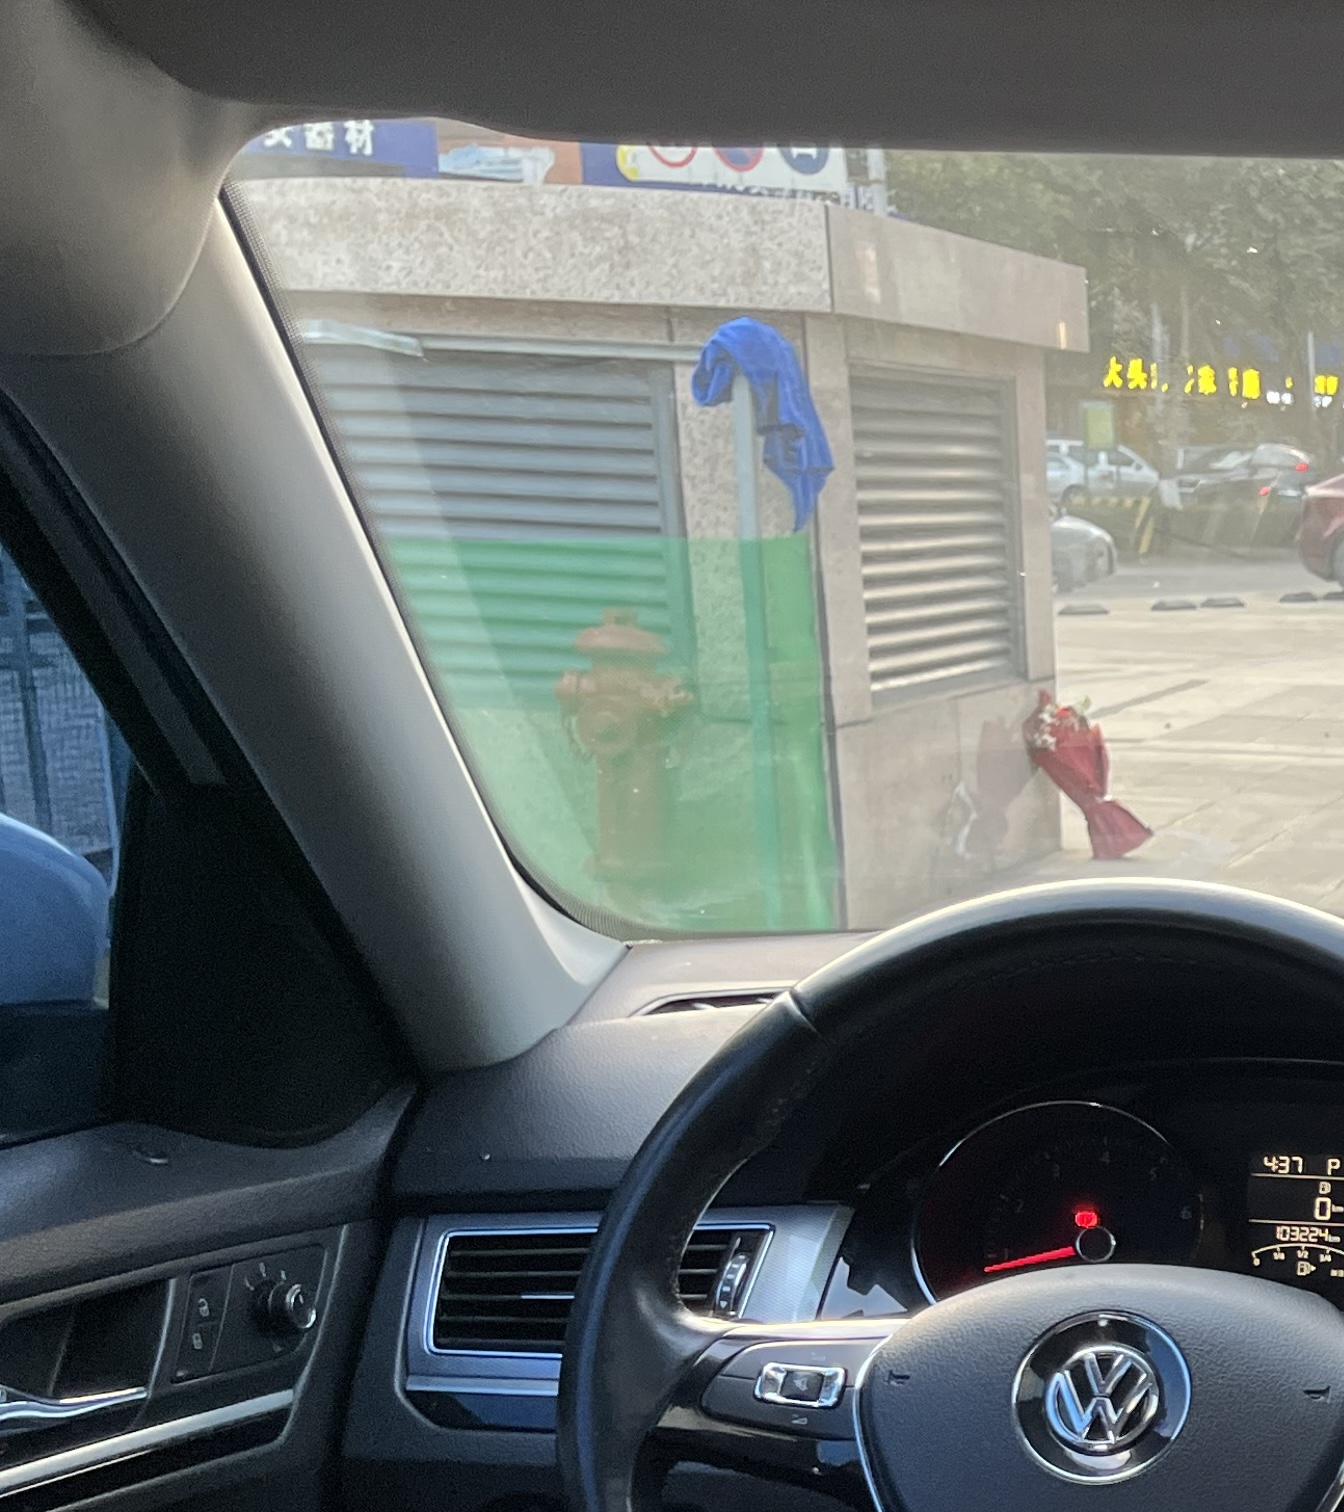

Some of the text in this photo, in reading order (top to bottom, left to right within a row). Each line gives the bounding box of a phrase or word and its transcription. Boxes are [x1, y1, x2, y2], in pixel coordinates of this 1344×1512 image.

[1327, 1158, 1341, 1175] P
[1314, 1196, 1332, 1221] 0
[1276, 1226, 1328, 1242] 103224
